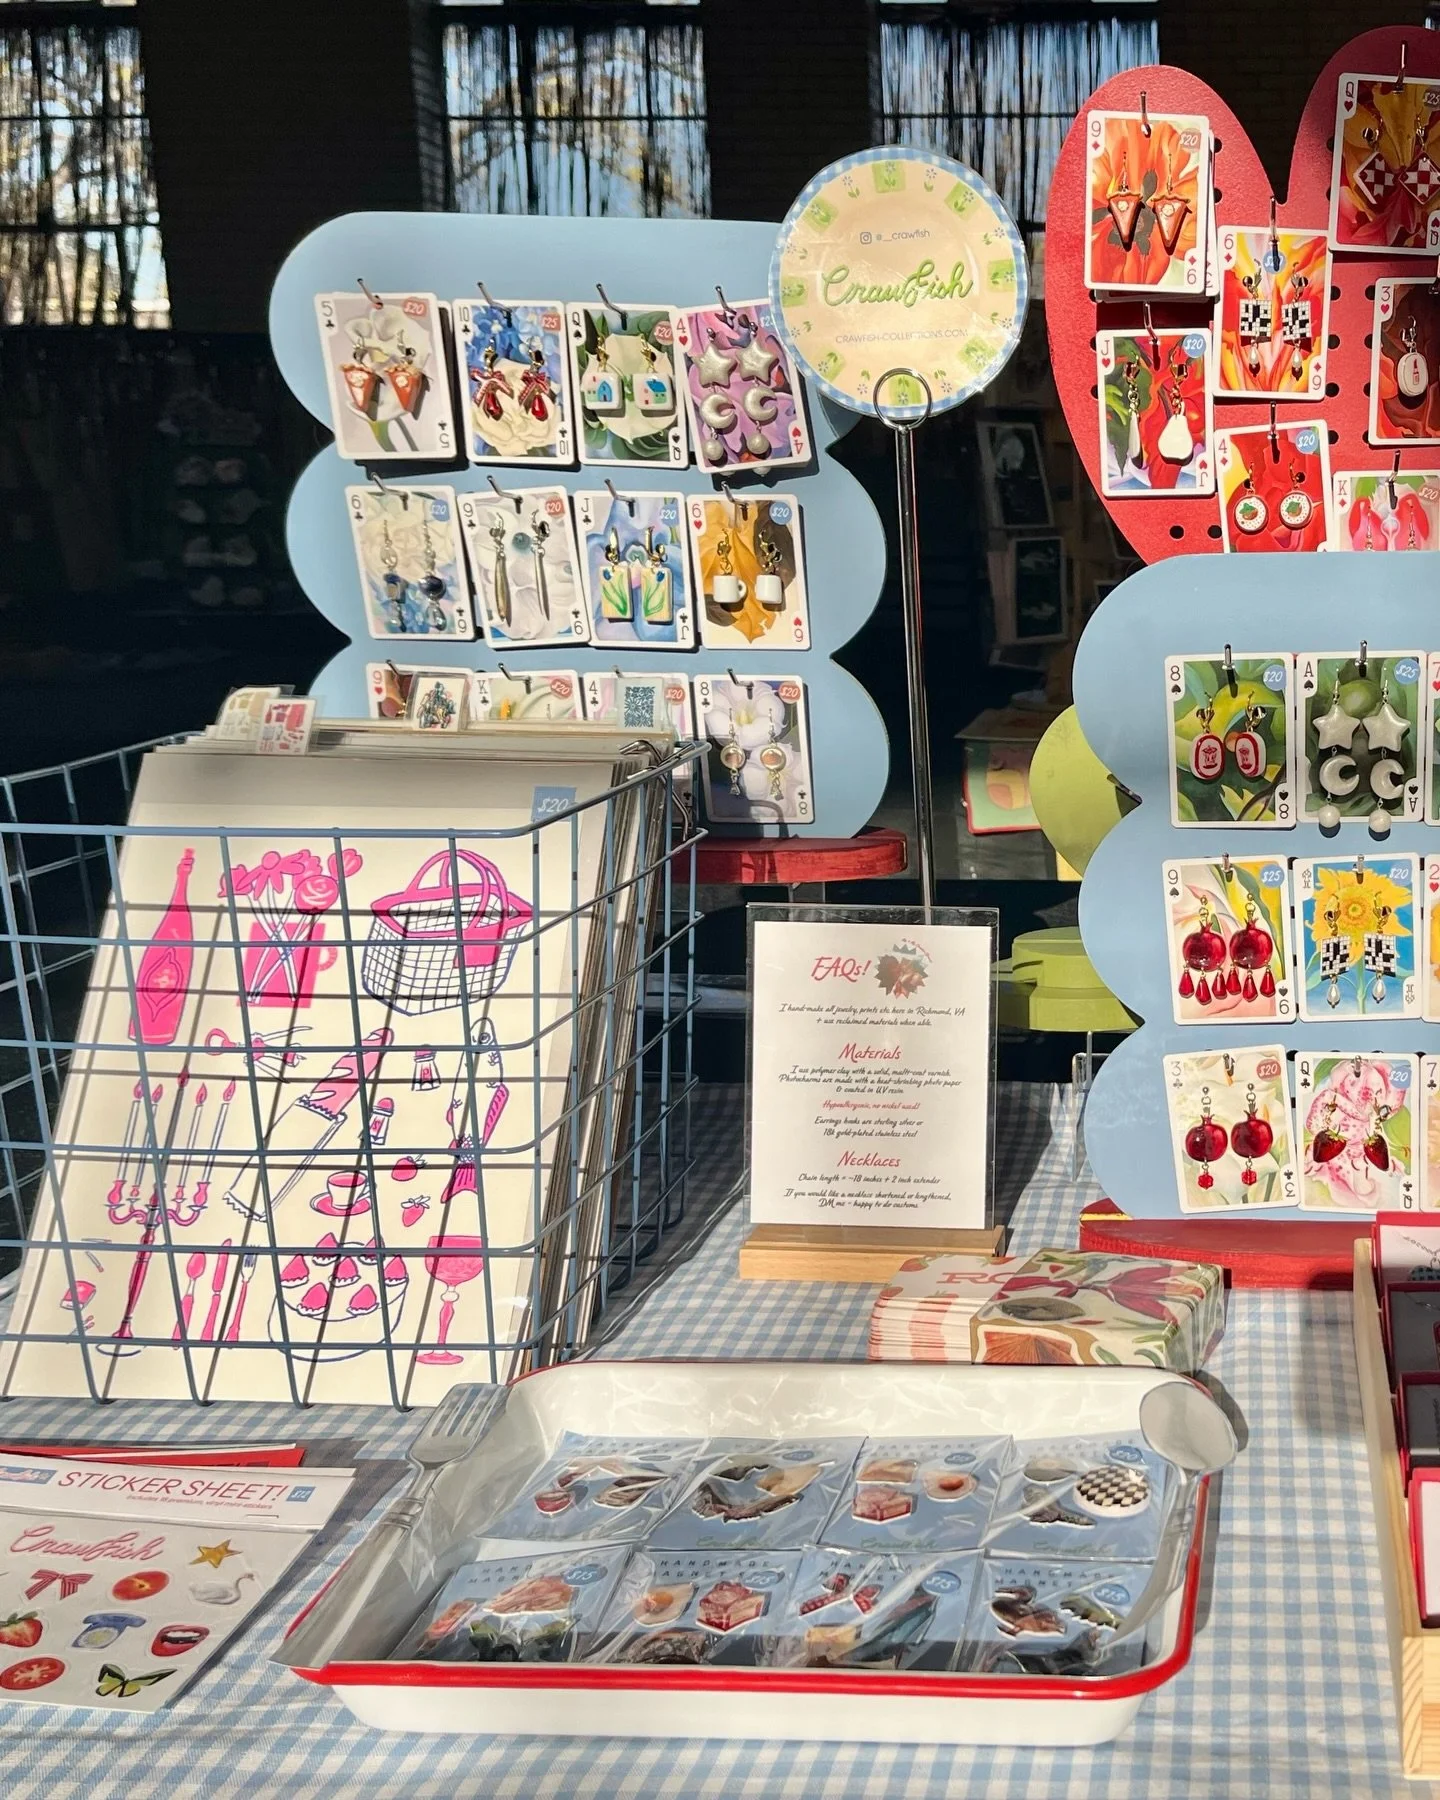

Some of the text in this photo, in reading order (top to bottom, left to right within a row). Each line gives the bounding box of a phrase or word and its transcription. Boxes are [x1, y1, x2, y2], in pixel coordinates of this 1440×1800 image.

[1346, 82, 1354, 98] Q
[1092, 121, 1101, 137] 9
[1180, 134, 1198, 146] $20
[1224, 234, 1234, 249] 6
[1430, 230, 1438, 246] Q
[822, 259, 974, 308] Crawfish
[1187, 269, 1197, 284] 9
[1381, 286, 1391, 301] 3
[322, 301, 333, 317] 5
[404, 301, 424, 315] $20
[459, 306, 469, 322] 10
[543, 316, 558, 328] $25
[572, 312, 581, 327] Q
[677, 318, 686, 333] 4
[654, 327, 671, 338] $20
[1101, 340, 1110, 355] J
[1185, 339, 1203, 350] $20
[440, 433, 449, 448] 5
[559, 440, 569, 455] 10
[794, 440, 803, 454] 4
[1218, 439, 1227, 454] 4
[1297, 434, 1315, 448] $20
[674, 445, 681, 460] Q
[1200, 472, 1208, 487] J
[1338, 480, 1347, 495] K
[1419, 488, 1438, 500] $20
[352, 495, 361, 509] 6
[546, 502, 561, 512] $20
[581, 498, 589, 512] J
[431, 505, 446, 514] $20
[463, 503, 473, 517] 9
[660, 509, 676, 519] $20
[692, 504, 701, 518] 6
[771, 507, 789, 518] $20
[681, 626, 689, 641] J
[1170, 665, 1181, 681] 8
[1304, 661, 1314, 677] A
[1396, 665, 1416, 678] $25
[373, 670, 383, 685] 9
[1264, 671, 1283, 683] $20
[477, 680, 488, 694] K
[553, 683, 569, 694] $20
[589, 682, 598, 695] 4
[666, 689, 683, 699] $20
[700, 682, 709, 696] 8
[781, 687, 798, 698] $20
[537, 797, 569, 812] $20
[799, 801, 808, 815] 8
[1279, 804, 1289, 819] 8
[1408, 797, 1418, 813] A
[1168, 869, 1178, 885] 9
[1261, 871, 1281, 883] $25
[1389, 868, 1409, 879] $20
[1429, 864, 1440, 880] 2
[811, 957, 872, 983] FAQs!
[859, 1006, 878, 1015] prints
[892, 1006, 905, 1014] here
[916, 1006, 951, 1017] Richmond,
[954, 1007, 966, 1016] VA
[836, 1017, 868, 1025] reclaimed
[869, 1018, 898, 1026] materials
[900, 1018, 916, 1026] when
[838, 1043, 902, 1063] Materials
[810, 1066, 836, 1077] polymer
[837, 1067, 850, 1077] clay
[852, 1067, 866, 1075] with
[874, 1067, 890, 1076] solid,
[891, 1068, 926, 1076] multi-coat
[1171, 1061, 1181, 1076] 3
[1259, 1064, 1277, 1077] $20
[1301, 1061, 1310, 1076] Q
[1427, 1063, 1437, 1078] 7
[779, 1073, 821, 1083] Photocharms
[834, 1076, 852, 1084] made
[855, 1076, 869, 1084] with
[876, 1077, 922, 1088] heat-shrinking
[923, 1078, 943, 1086] photo
[943, 1080, 962, 1088] paper
[1389, 1071, 1408, 1082] $20
[875, 1086, 889, 1094] UV
[815, 1116, 841, 1127] Earrings
[844, 1117, 859, 1125] hooks
[874, 1118, 897, 1128] sterling
[898, 1118, 915, 1126] silver
[823, 1128, 918, 1139] 18k gold-plated stainless steel
[837, 1151, 901, 1168] Necklaces
[799, 1173, 817, 1182] Chain
[820, 1174, 839, 1185] length
[794, 1191, 806, 1199] you
[808, 1189, 827, 1197] would
[828, 1189, 839, 1197] like
[875, 1191, 906, 1199] shortened
[1285, 1183, 1295, 1198] 3
[818, 1198, 835, 1208] DM
[853, 1199, 873, 1210] happy
[1403, 1193, 1412, 1209] Q
[58, 1471, 182, 1494] STICKER
[182, 1480, 289, 1501] SHEET!
[10, 1525, 166, 1561] Crawfish
